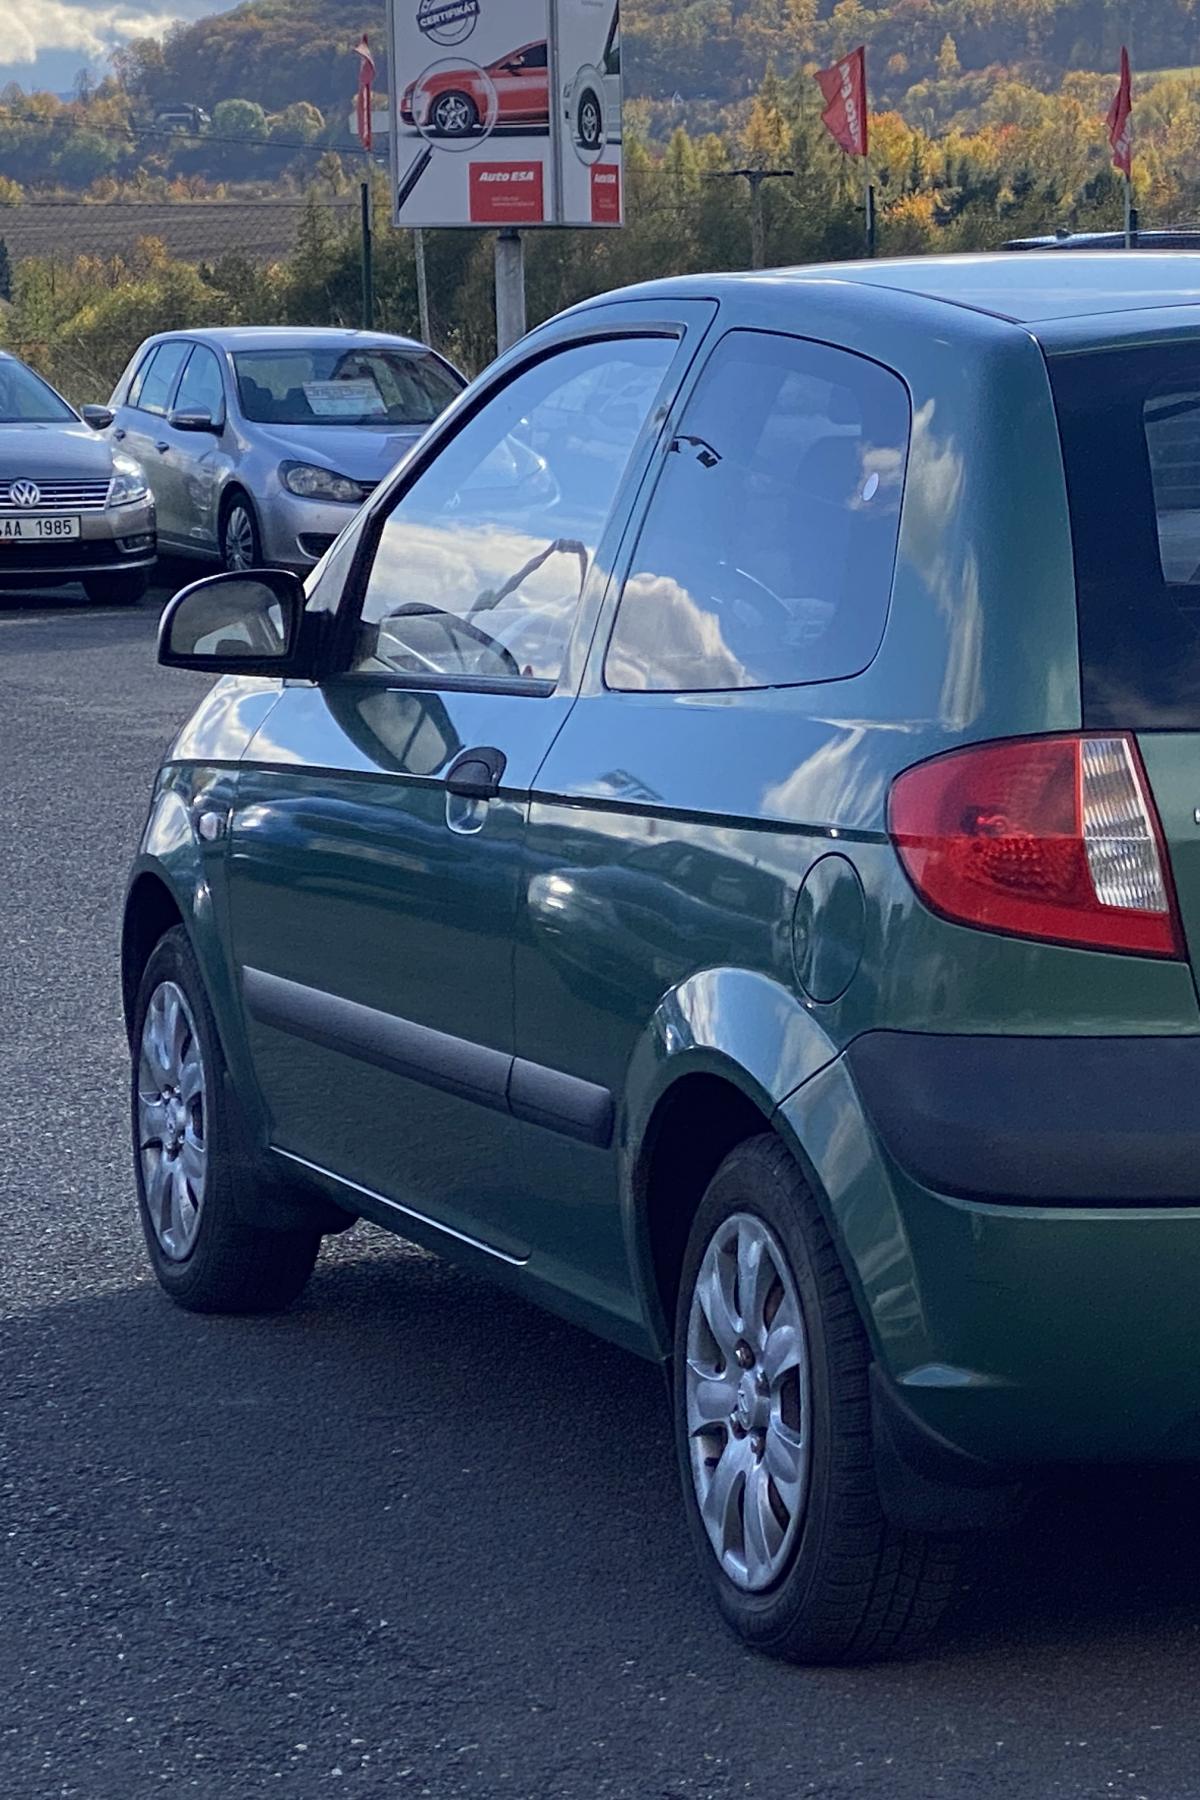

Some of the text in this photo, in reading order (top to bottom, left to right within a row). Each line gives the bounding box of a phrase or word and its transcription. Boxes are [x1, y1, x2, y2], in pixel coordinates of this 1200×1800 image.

[420, 1, 477, 26] CERTIFIKÁT
[480, 171, 534, 182] Auto ESA
[0, 520, 72, 536] AA 1985
